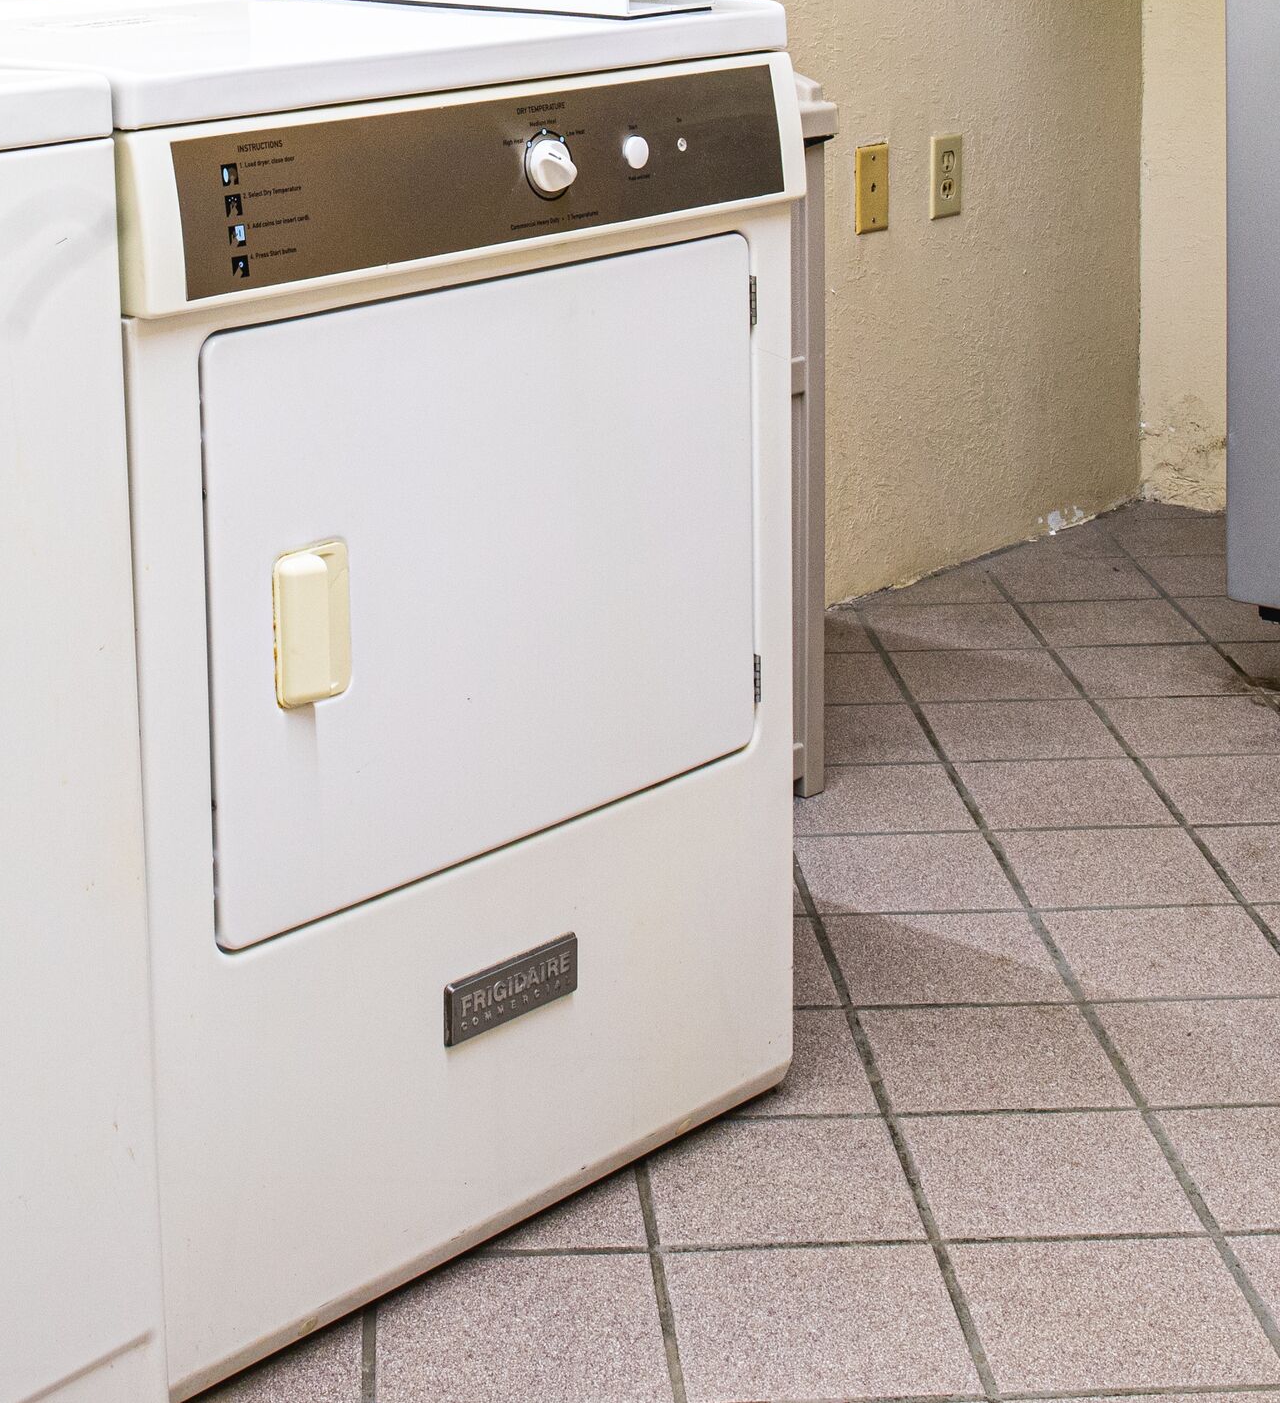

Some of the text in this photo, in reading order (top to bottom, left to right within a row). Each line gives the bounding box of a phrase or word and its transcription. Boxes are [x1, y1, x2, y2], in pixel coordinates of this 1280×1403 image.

[517, 102, 565, 115] DRY TEMPERATURE
[237, 140, 283, 153] INSTRUCTIONS
[503, 139, 511, 147] High
[272, 186, 301, 194] Temperature
[511, 222, 535, 231] Commercial
[537, 219, 549, 227] Heavy
[571, 211, 598, 220] Temperatures
[461, 951, 570, 1017] FRIGIDAIRE
[461, 975, 572, 1030] COMMERCIAL
